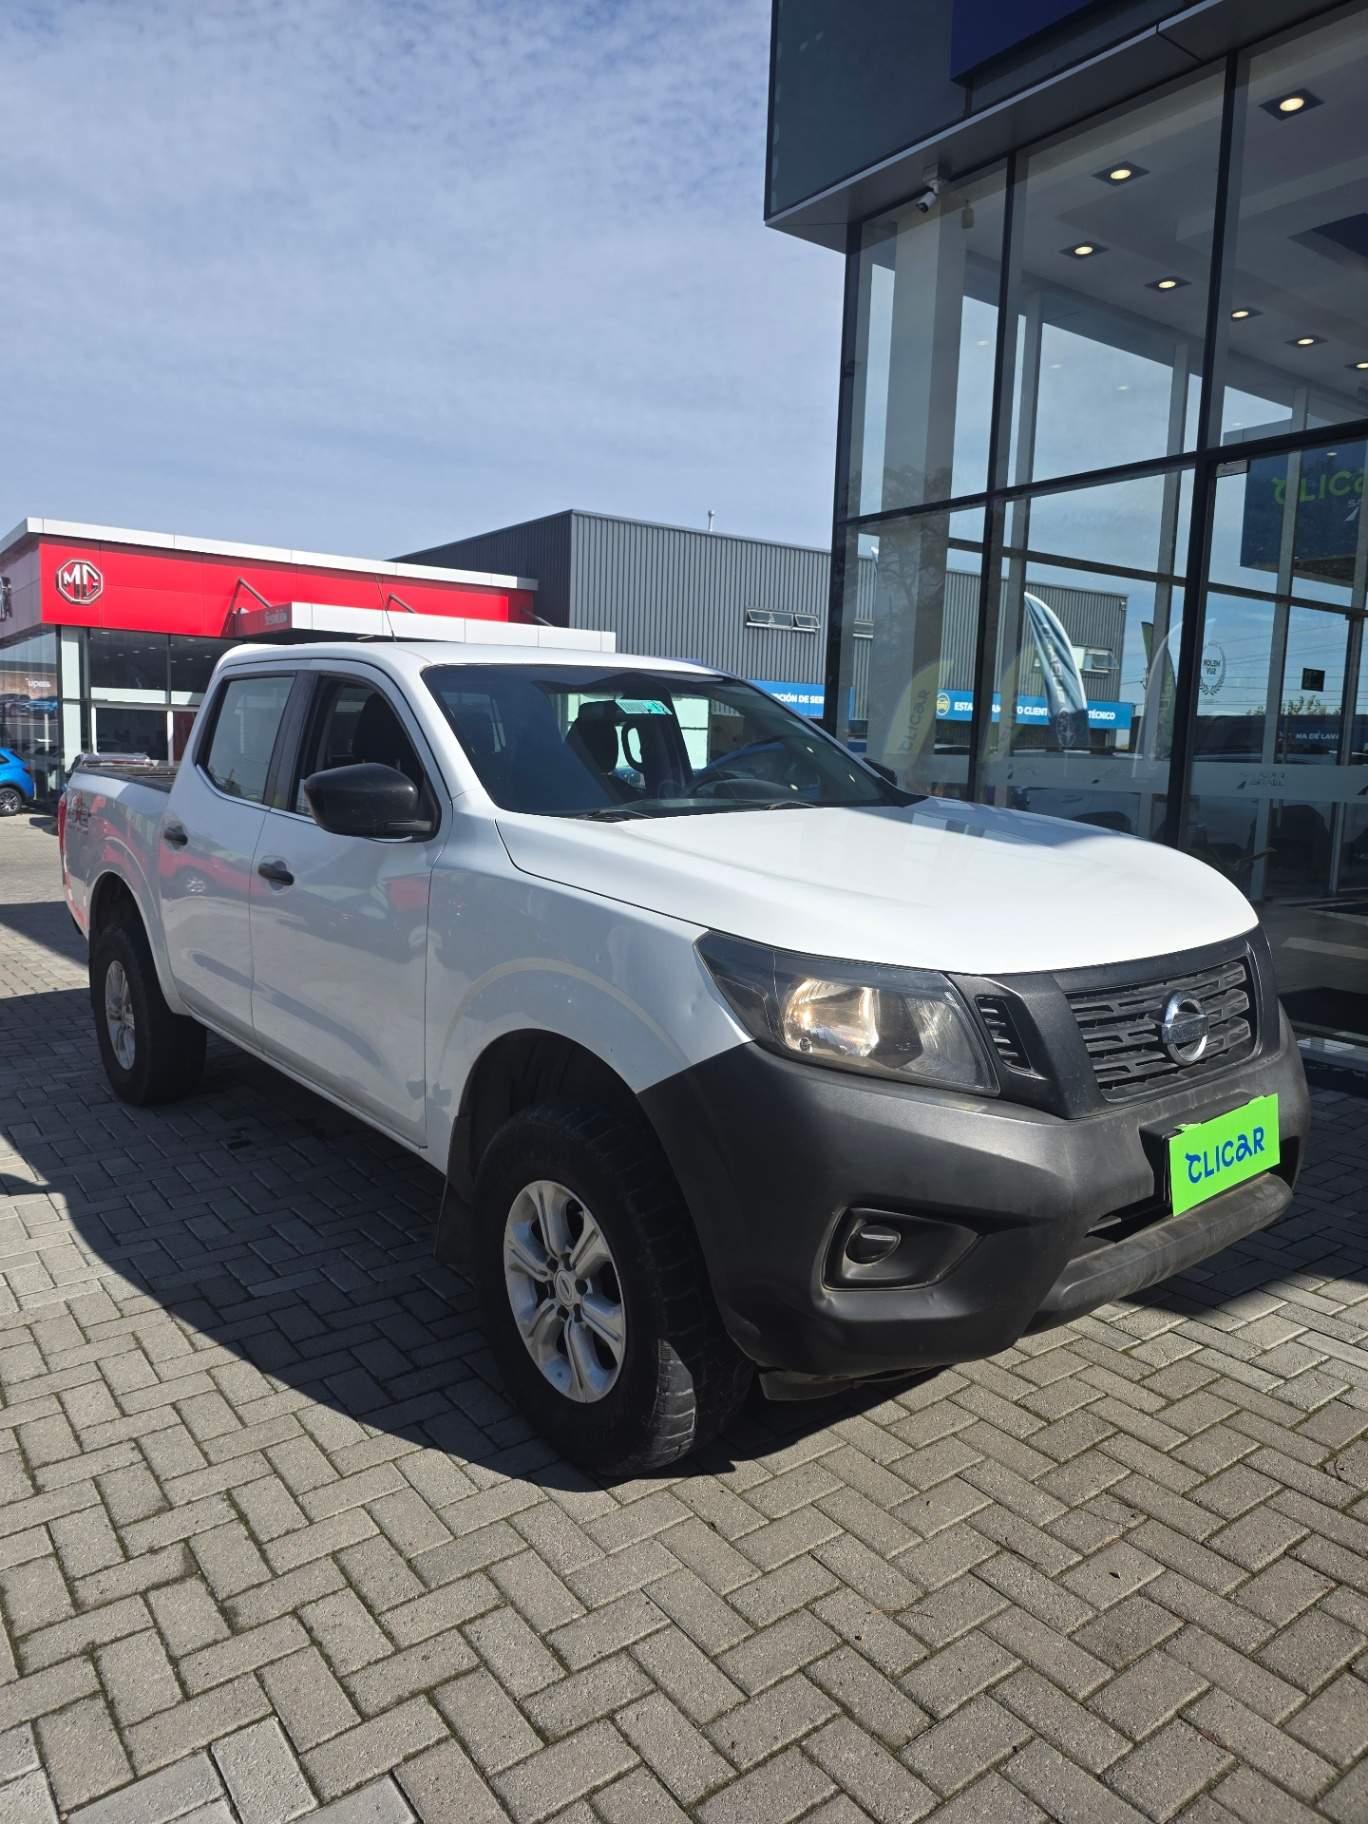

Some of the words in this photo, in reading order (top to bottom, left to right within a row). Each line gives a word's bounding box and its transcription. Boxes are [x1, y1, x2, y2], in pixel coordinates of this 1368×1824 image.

[61, 562, 100, 600] MG
[798, 694, 809, 704] DE
[809, 695, 824, 704] SER
